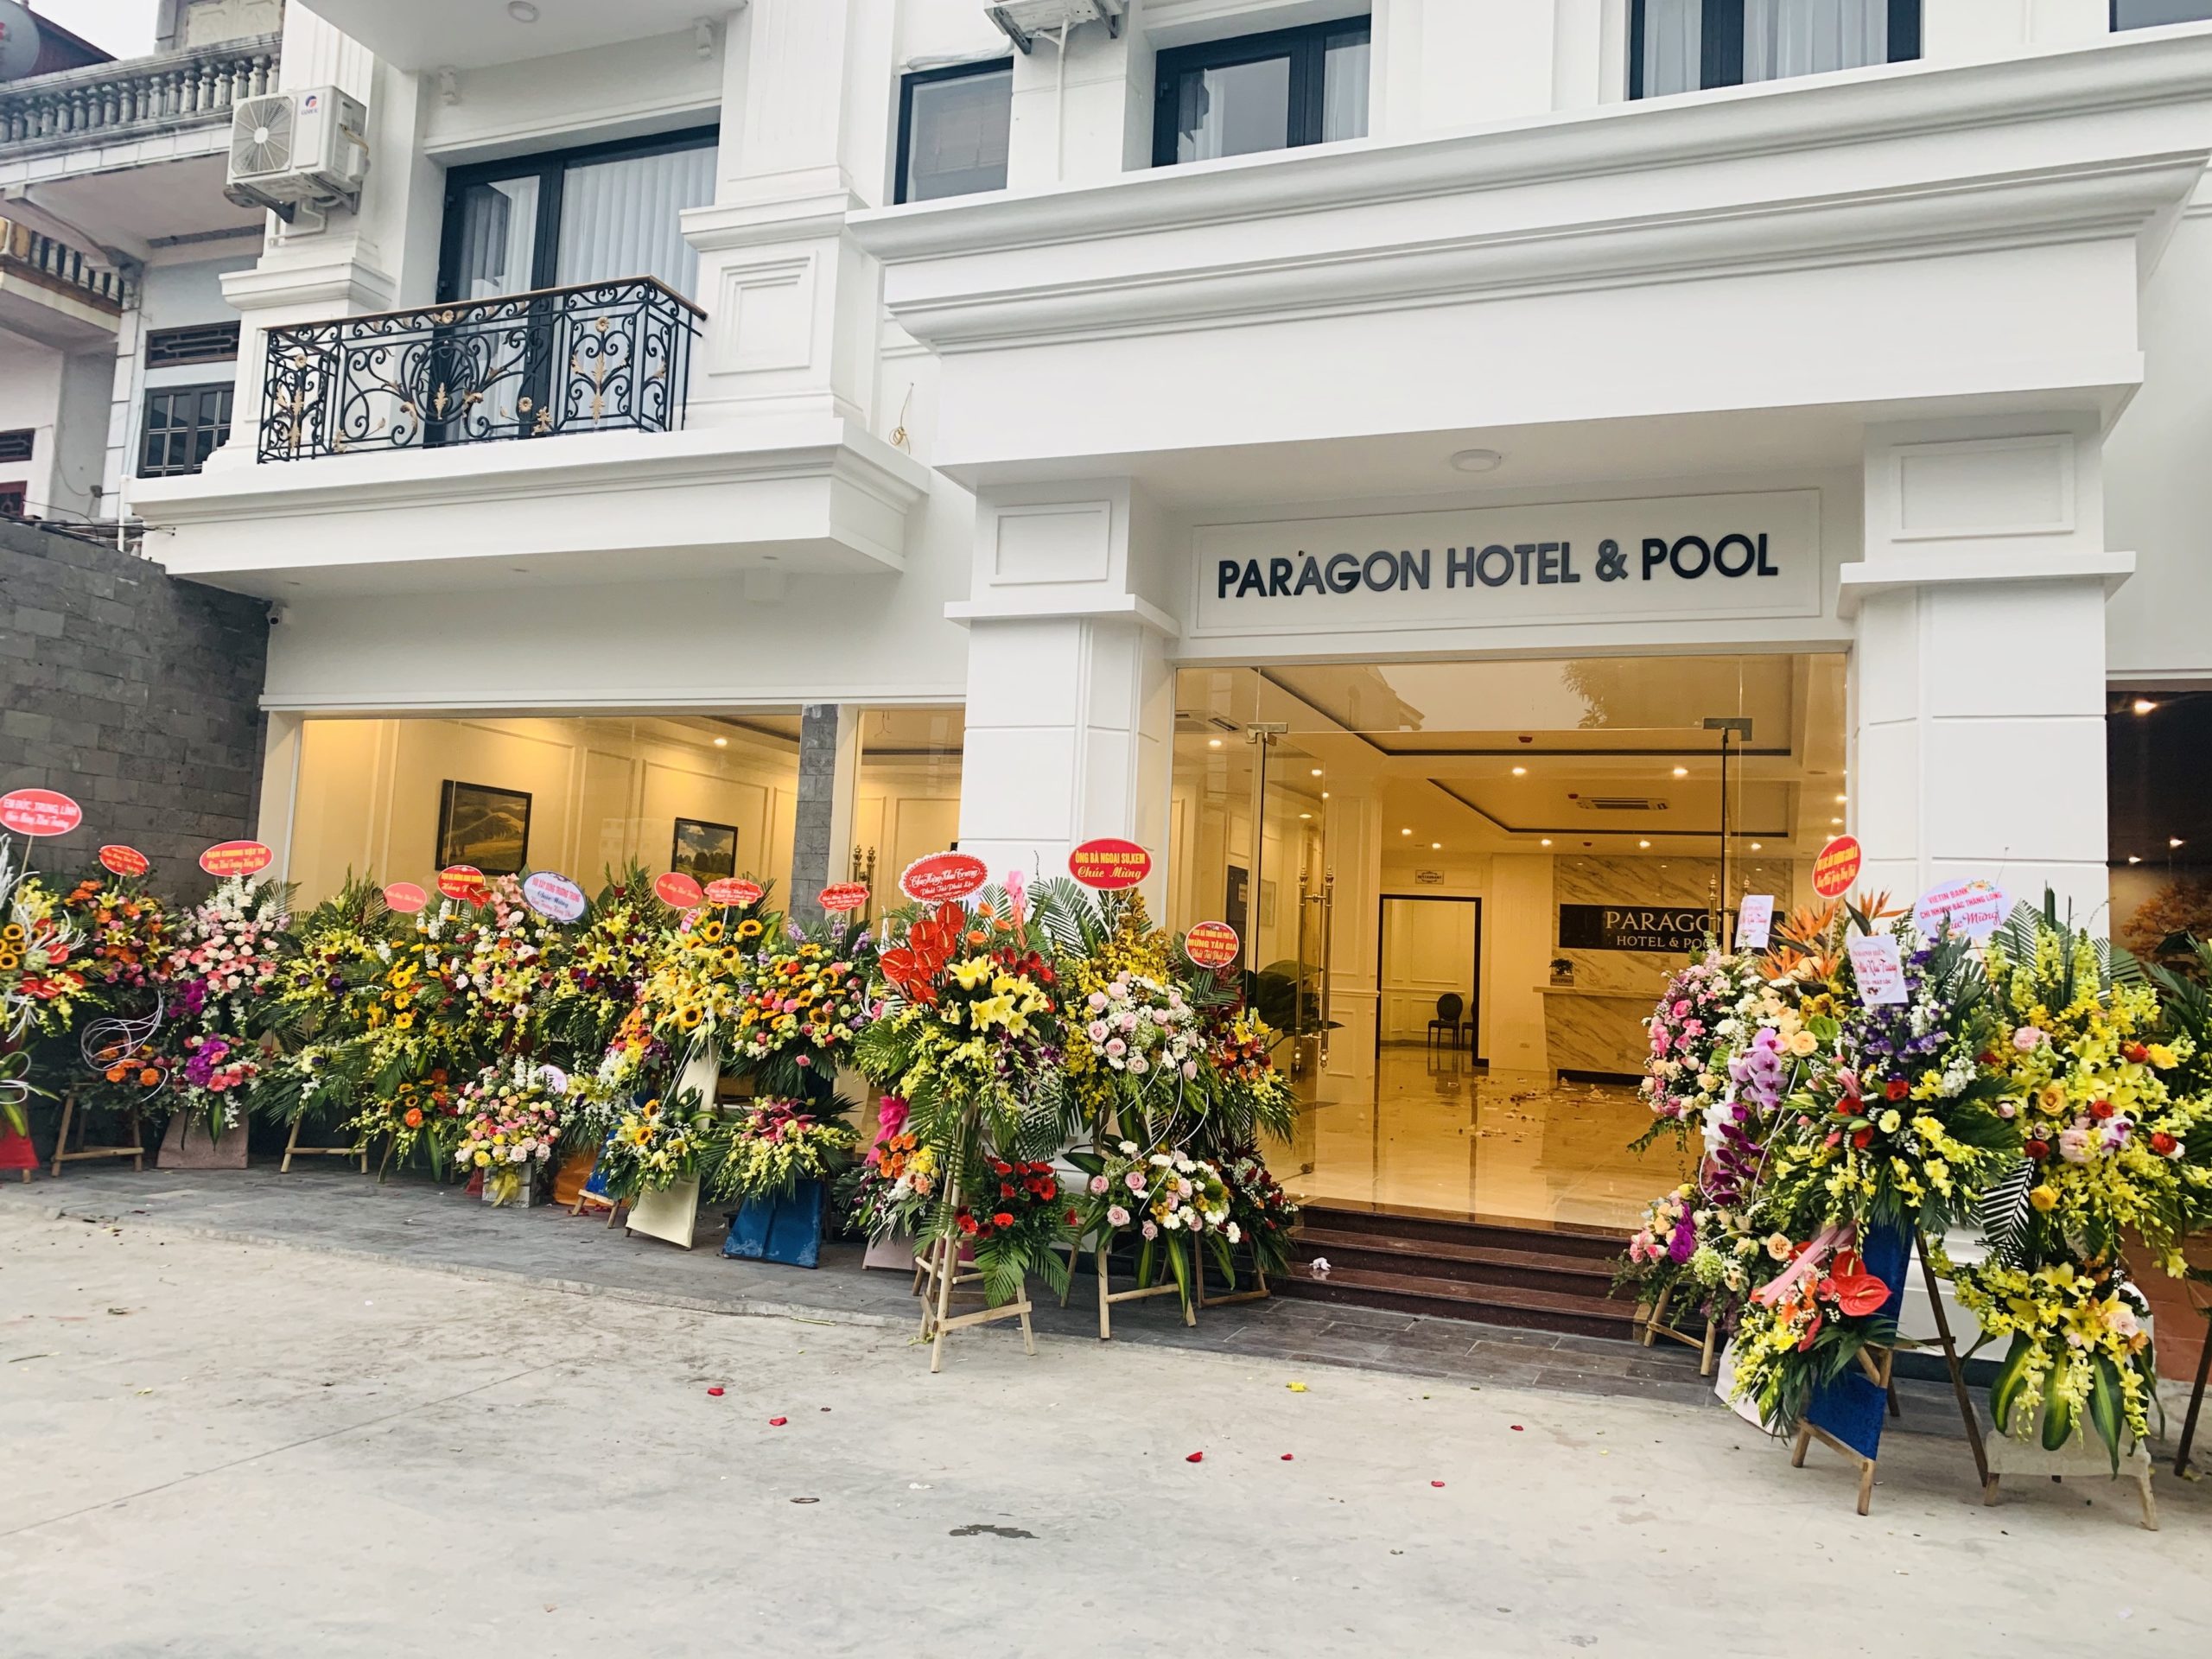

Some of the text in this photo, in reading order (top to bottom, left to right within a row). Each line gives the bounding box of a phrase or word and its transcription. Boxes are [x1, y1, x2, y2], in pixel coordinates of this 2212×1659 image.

[1217, 533, 1779, 598] PARAGON HOTEL & POOL
[1075, 850, 1089, 864] ÔNG
[1090, 850, 1099, 864] BÀ
[1100, 852, 1120, 866] NGOẠI
[1077, 866, 1105, 878] Chúc
[1950, 887, 1969, 899] BANK
[1920, 910, 1931, 919] CHI
[1986, 891, 2003, 902] LONG
[1187, 938, 1236, 951] MỪNG TÂN GIA
[1617, 936, 1665, 948] HOTEL
[1669, 937, 1679, 948] &
